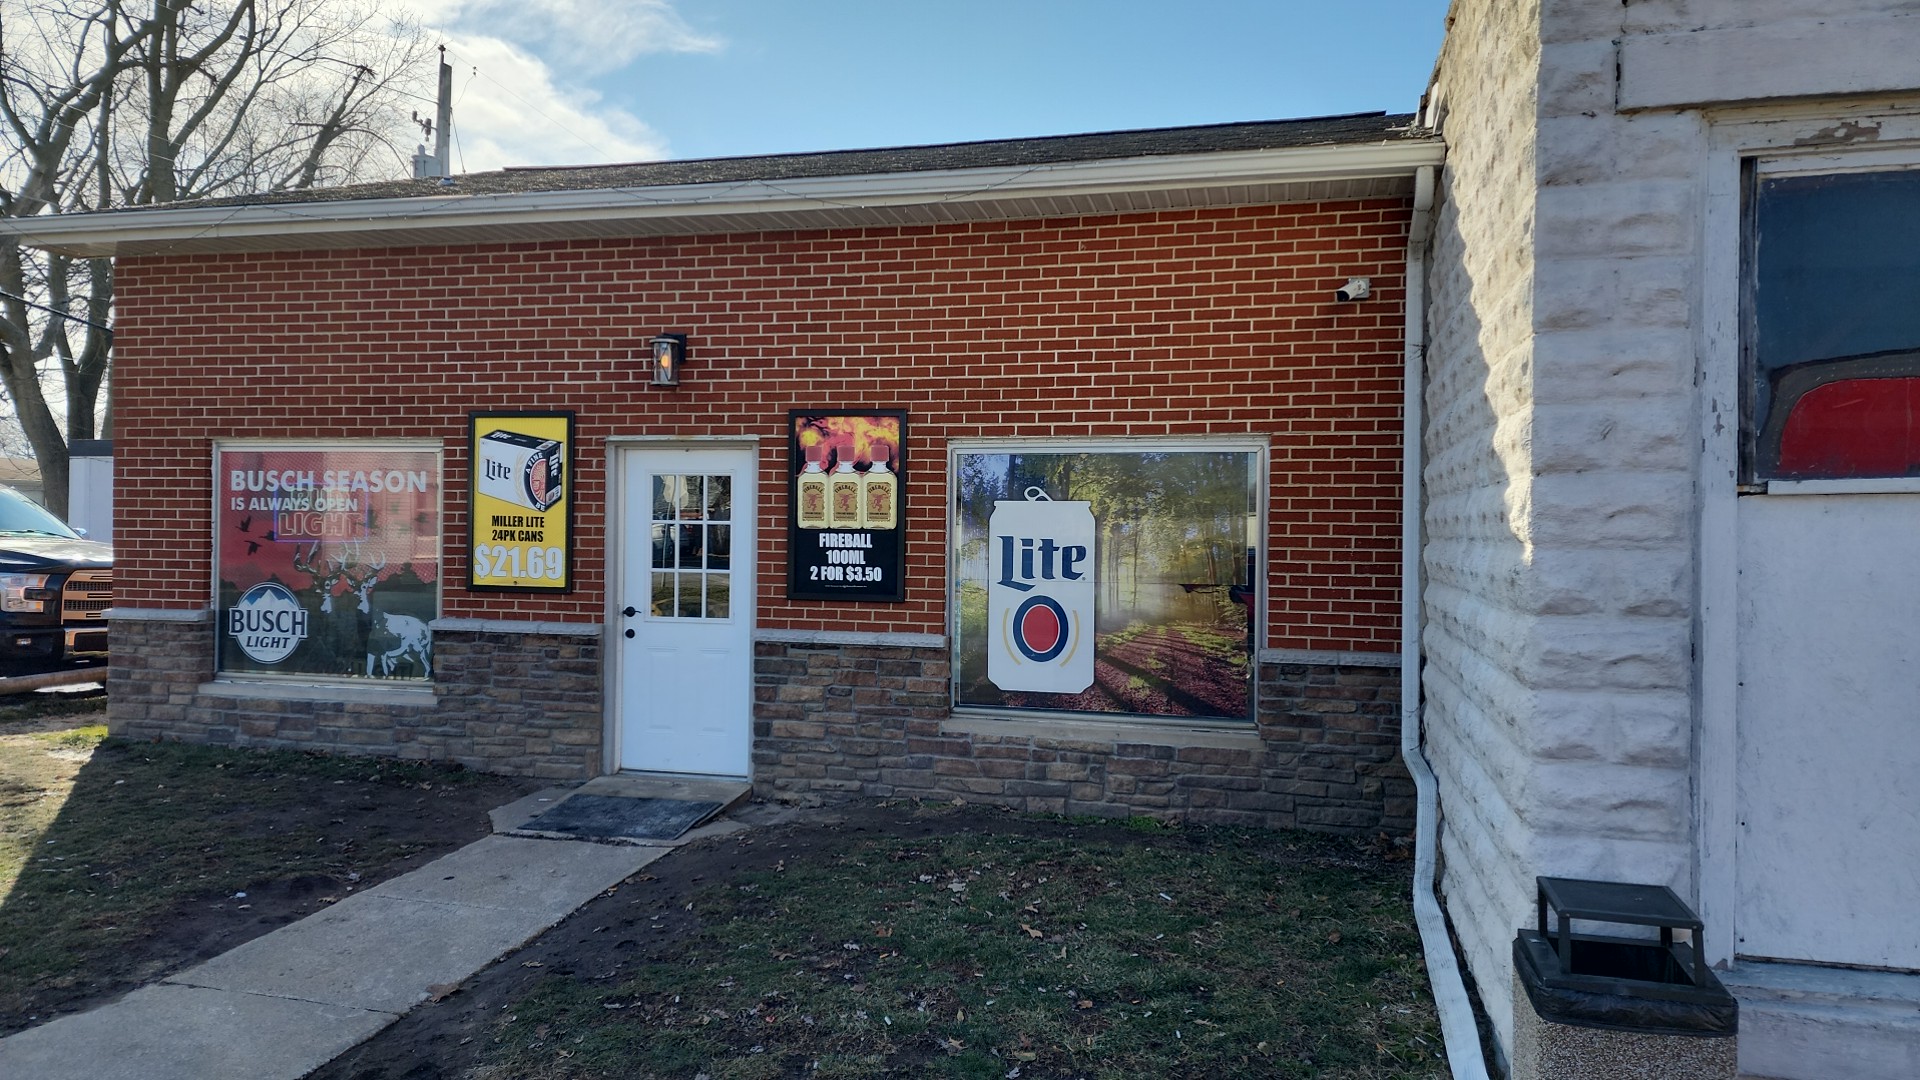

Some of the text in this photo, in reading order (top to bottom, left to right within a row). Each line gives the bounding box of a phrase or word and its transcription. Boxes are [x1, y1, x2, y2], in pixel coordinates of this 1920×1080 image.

[485, 458, 511, 481] Lite
[230, 470, 426, 493] BUSCH SEASON
[230, 497, 358, 512] IS ALWAYS OPEN
[278, 512, 363, 536] LIGHT
[491, 515, 545, 528] MILLER LITE
[491, 529, 544, 543] 24PK CANS
[819, 532, 873, 549] FIREBALL
[474, 542, 563, 580] $21.69
[825, 549, 866, 565] 100ML
[996, 535, 1087, 592] Lite
[809, 565, 883, 582] 2 FOR $3.50
[230, 609, 307, 636] BUSCH
[245, 636, 291, 649] LIGHT
